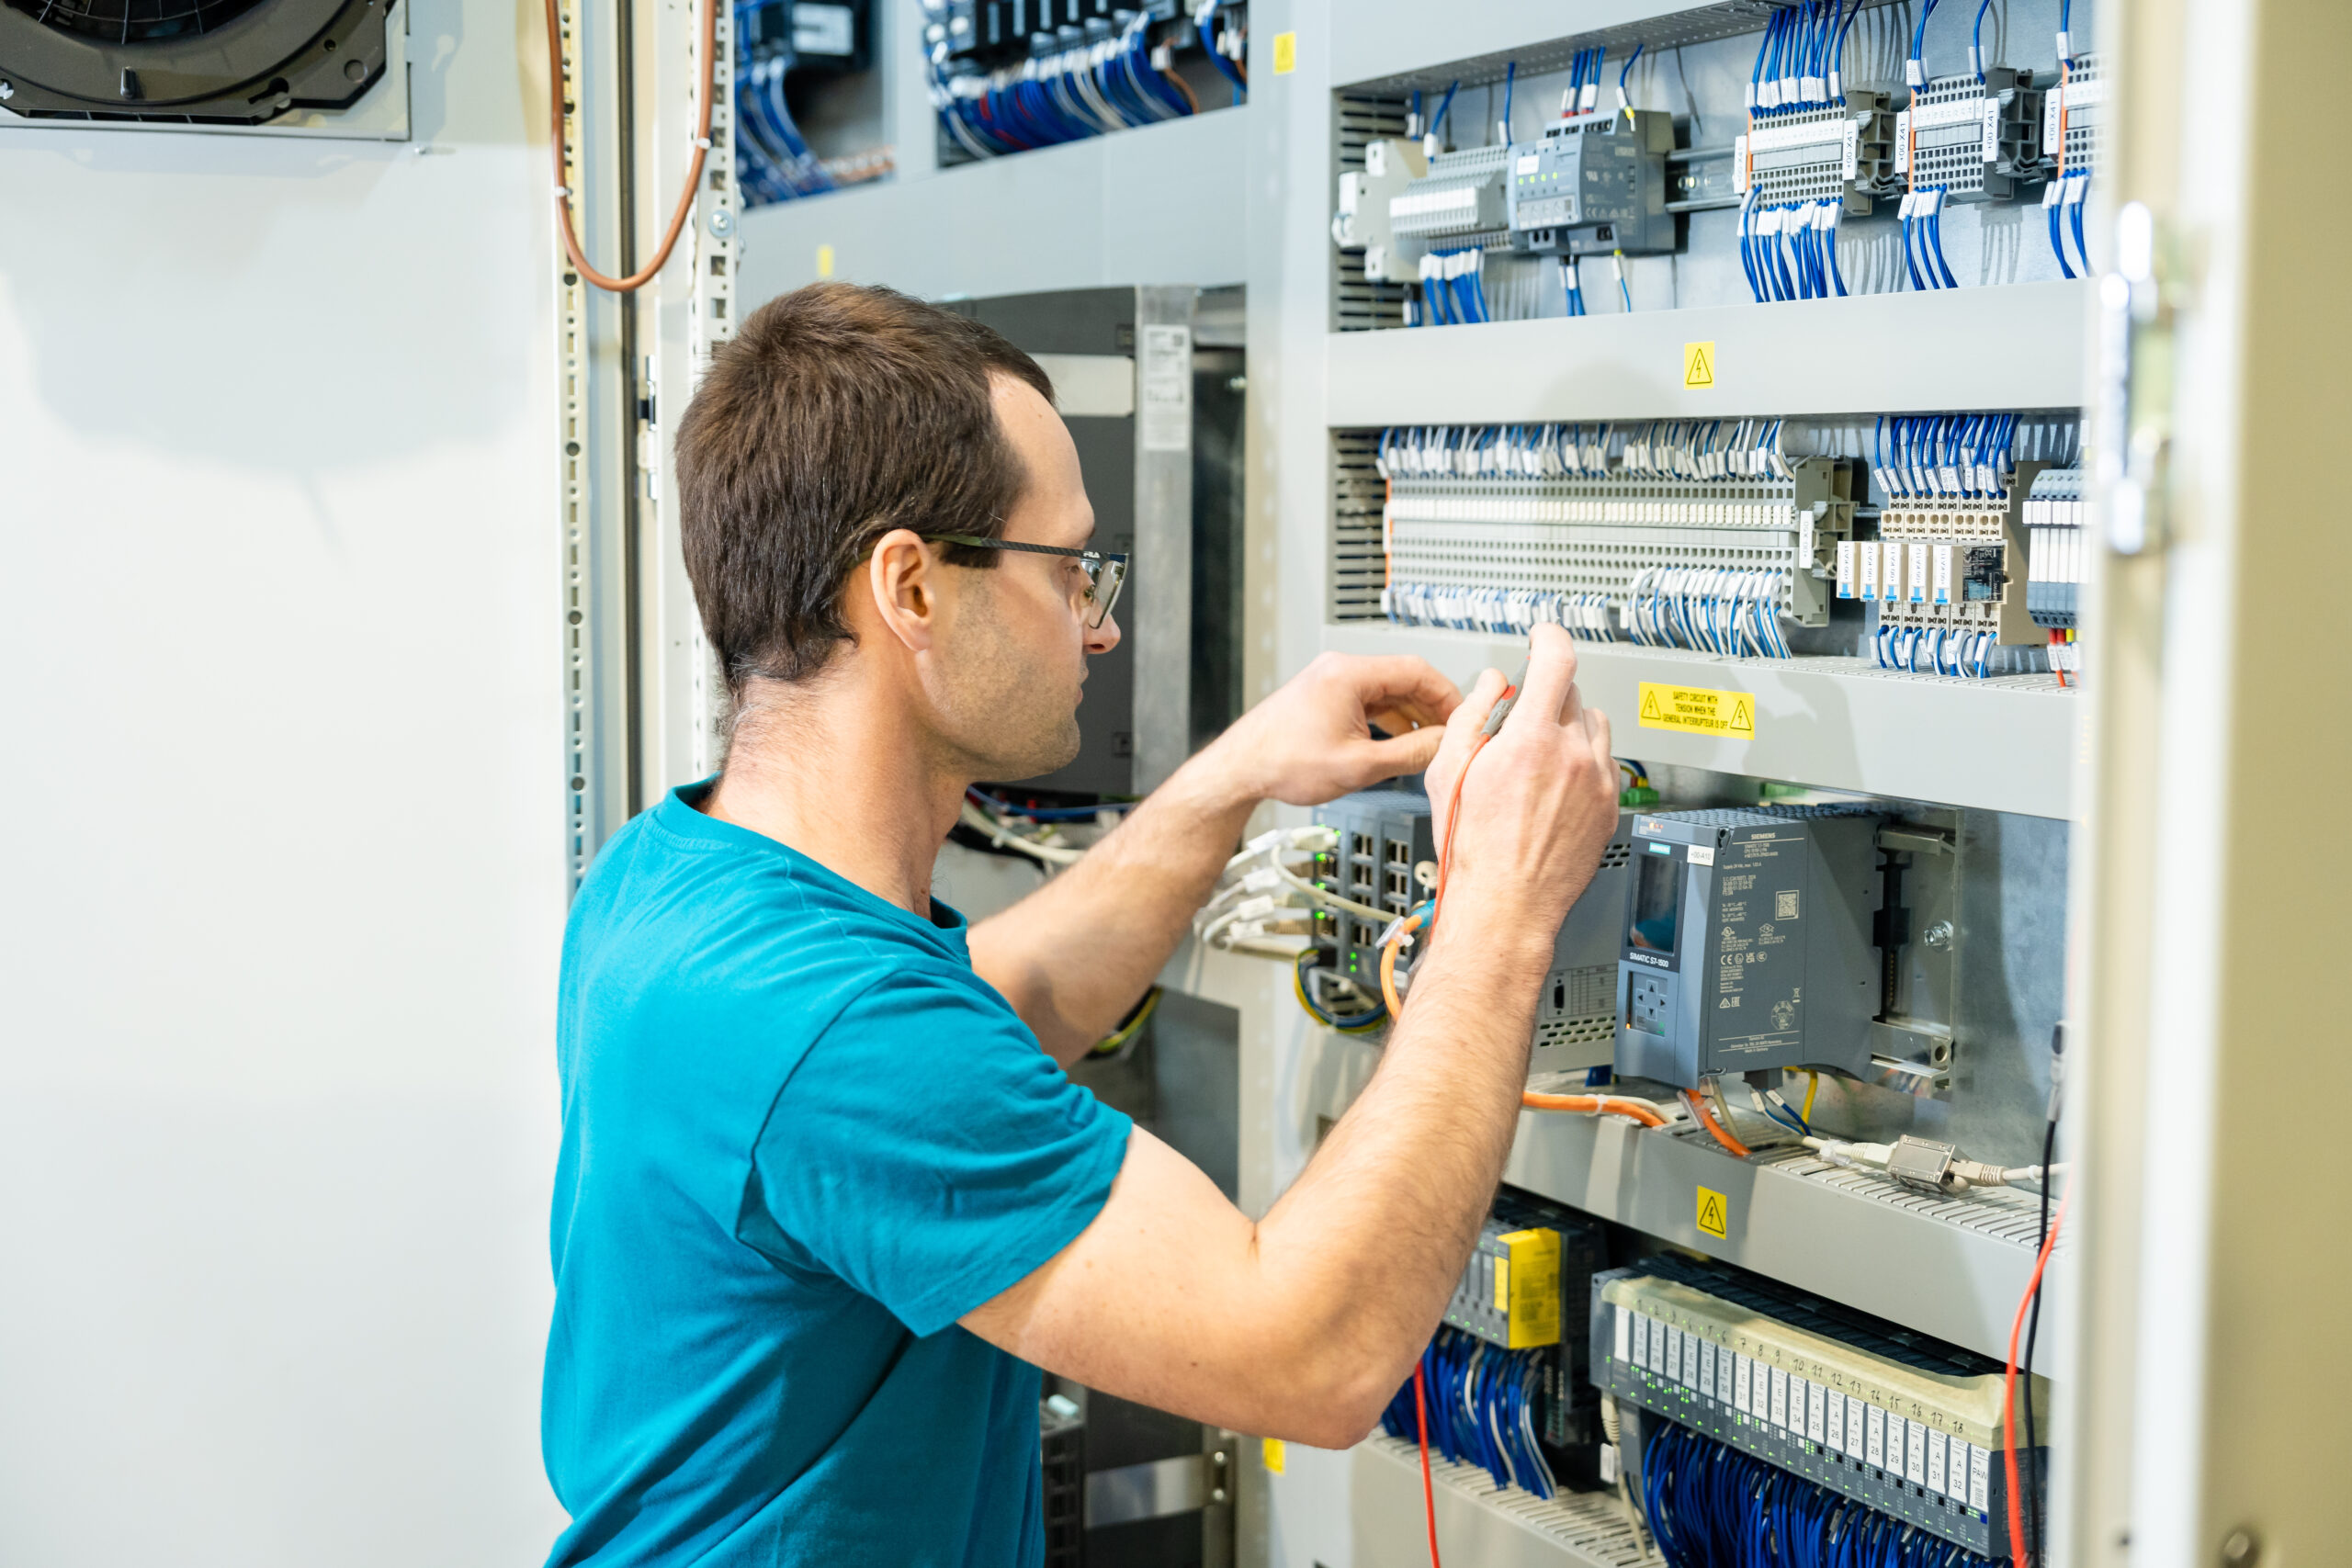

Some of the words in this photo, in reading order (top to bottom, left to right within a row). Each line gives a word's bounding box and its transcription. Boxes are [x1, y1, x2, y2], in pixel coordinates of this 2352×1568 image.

[1675, 703, 1692, 713] TENSION
[1694, 705, 1706, 715] WHEN
[1707, 706, 1716, 716] THE
[1663, 713, 1681, 724] GENERAL
[1751, 832, 1776, 840] SIEMENS
[1629, 952, 1650, 964] SIMATIC
[1650, 957, 1669, 968] S7-1500
[1758, 1344, 1763, 1357] 8
[1775, 1349, 1781, 1364] 9
[1793, 1359, 1804, 1371] 10
[1812, 1364, 1823, 1378] 11
[1831, 1372, 1842, 1386] 12
[1849, 1381, 1861, 1394] 13
[1871, 1390, 1880, 1404] 14
[1889, 1395, 1903, 1410] 15
[1912, 1404, 1922, 1417] 16
[1931, 1412, 1943, 1426] 17
[1952, 1420, 1963, 1433] 18
[1812, 1421, 1820, 1431] 25
[1831, 1429, 1838, 1439] 26
[1850, 1438, 1859, 1447] 27
[1871, 1446, 1879, 1456] 28
[1891, 1454, 1899, 1464] 29
[1911, 1462, 1920, 1472] 30
[1932, 1470, 1940, 1481] 31
[1953, 1479, 1962, 1489] 32
